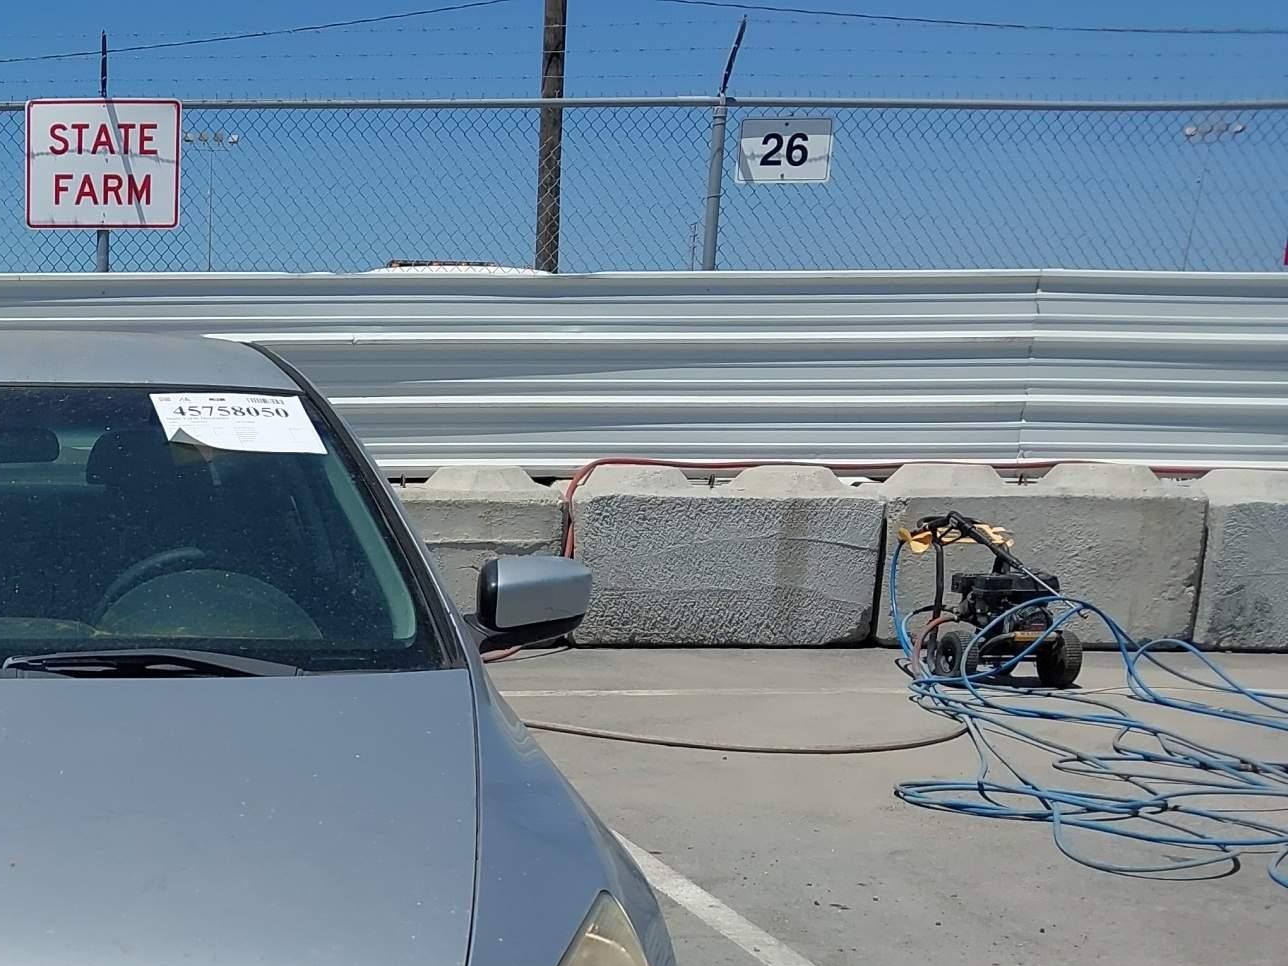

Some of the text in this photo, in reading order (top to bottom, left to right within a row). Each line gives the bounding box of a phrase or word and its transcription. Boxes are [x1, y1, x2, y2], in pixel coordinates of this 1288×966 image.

[49, 123, 158, 156] STATE
[759, 132, 809, 167] 26
[54, 174, 152, 206] FARM
[173, 404, 290, 418] 45758050
